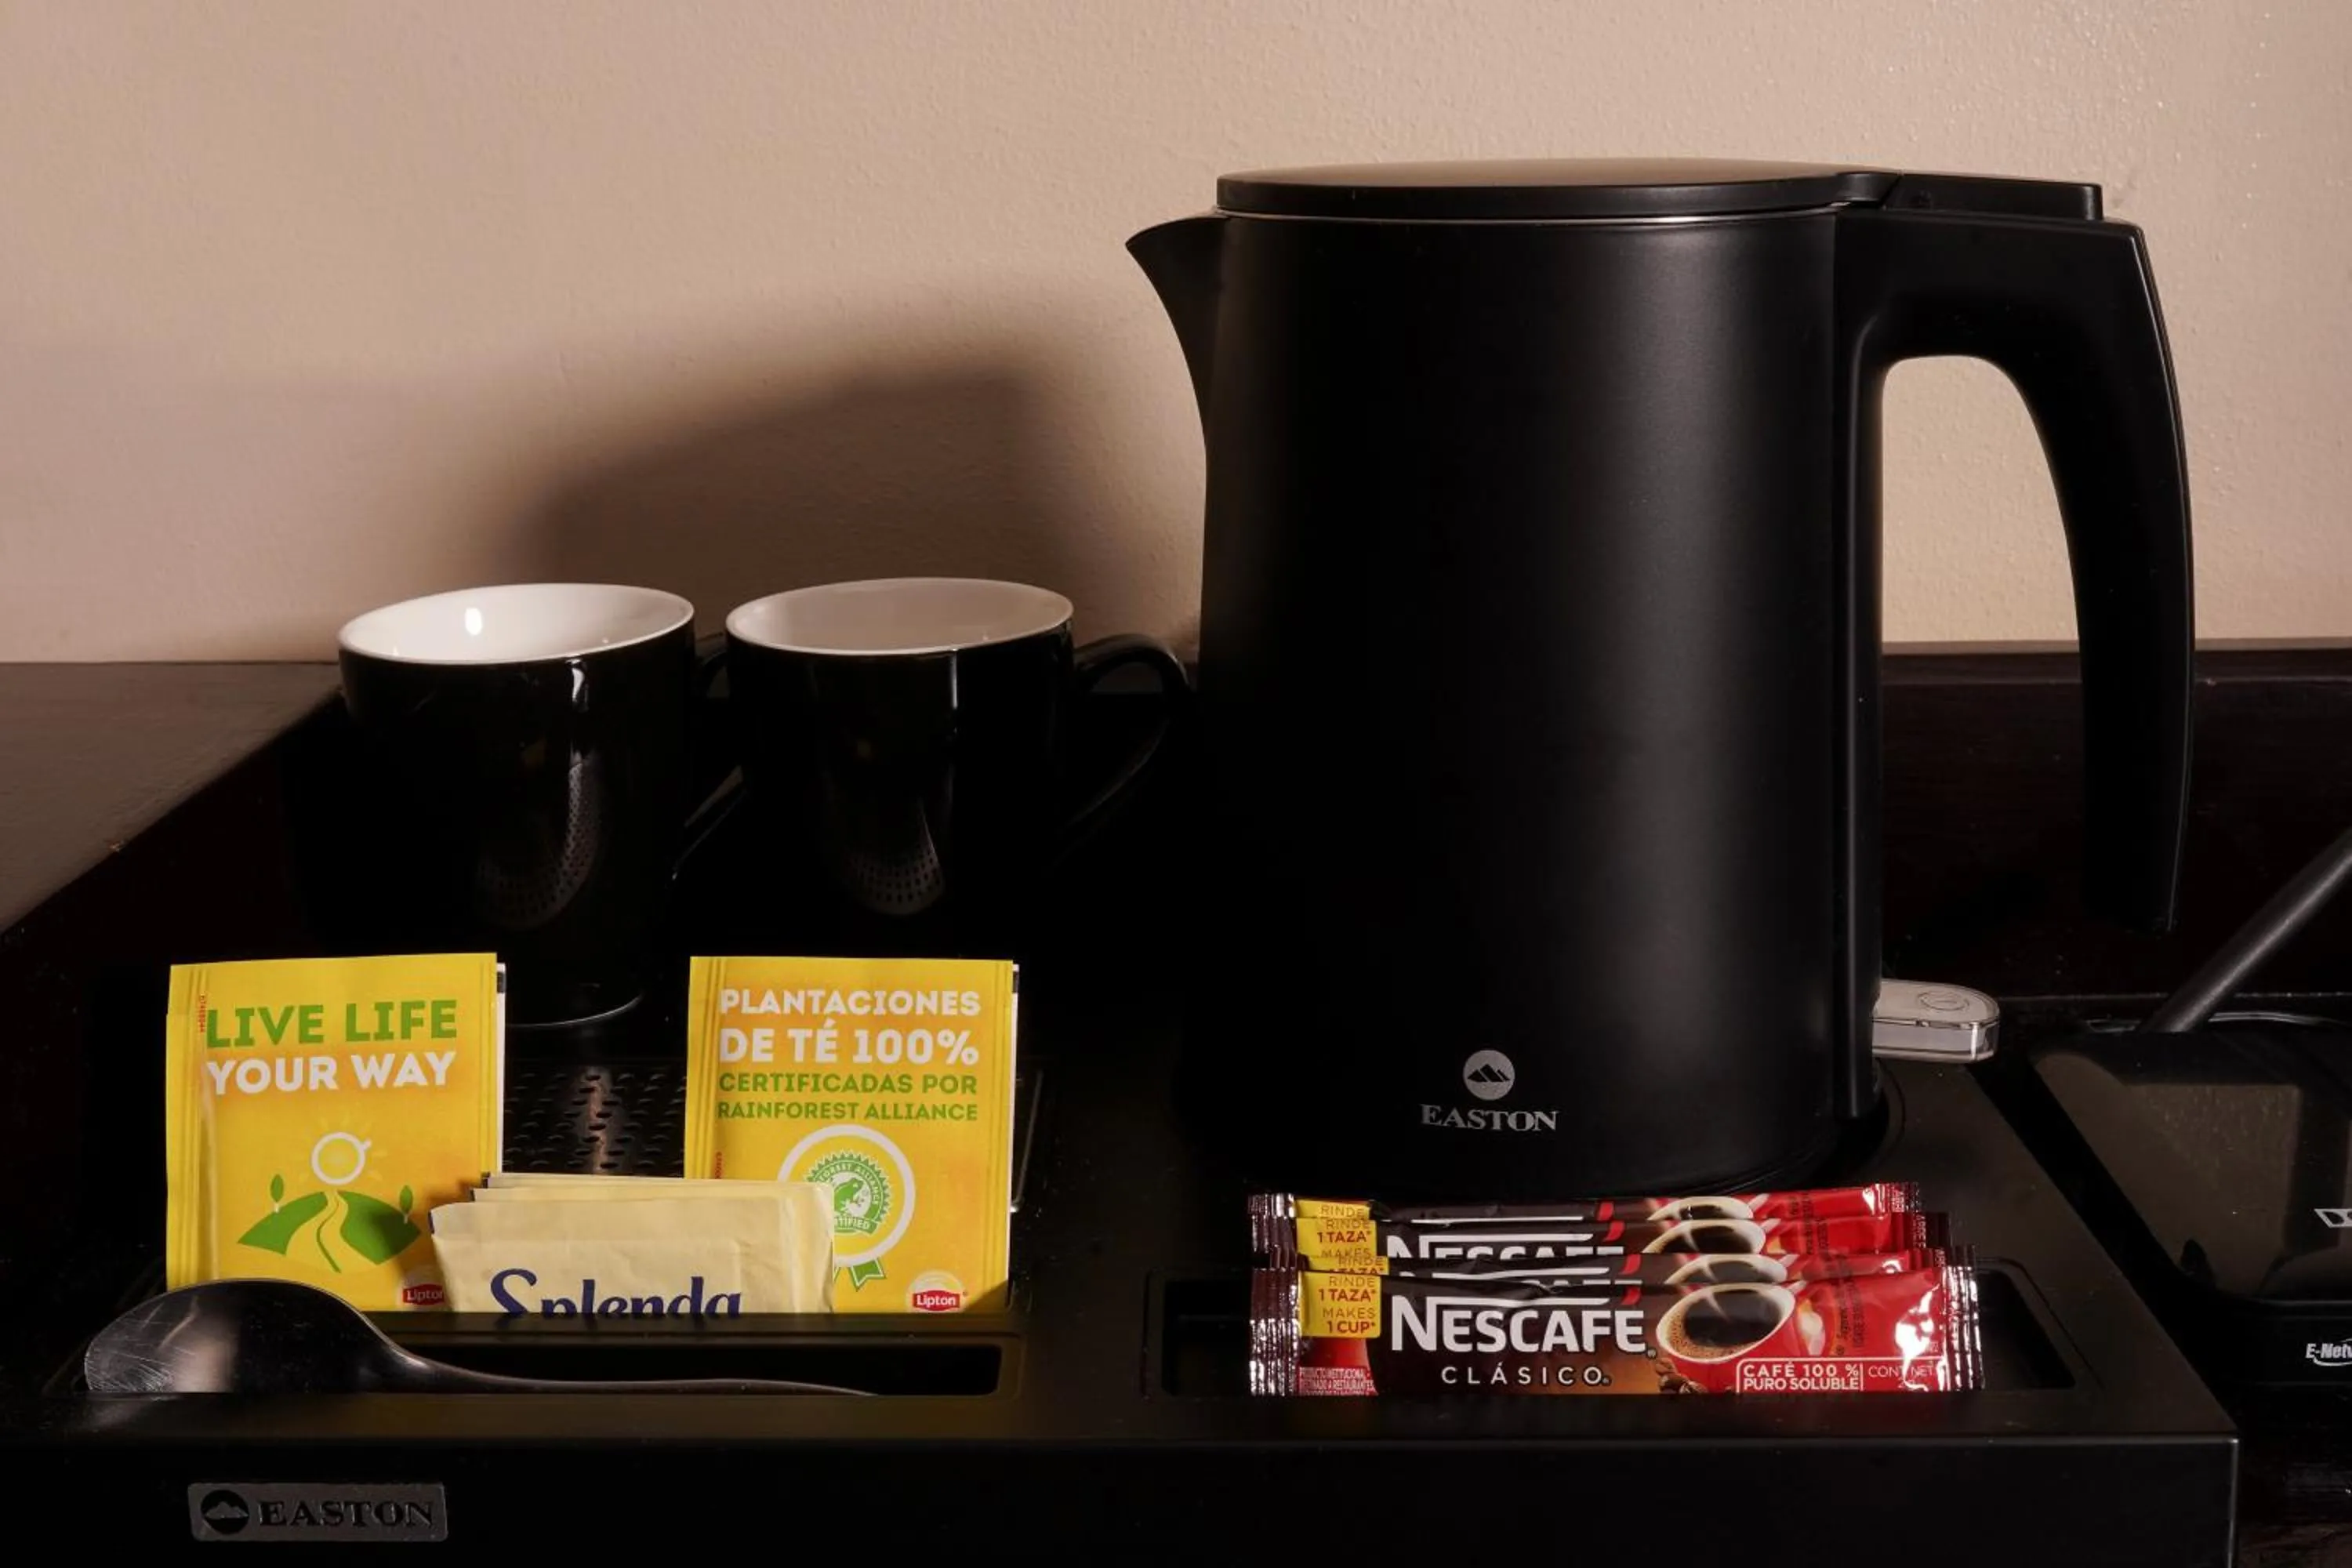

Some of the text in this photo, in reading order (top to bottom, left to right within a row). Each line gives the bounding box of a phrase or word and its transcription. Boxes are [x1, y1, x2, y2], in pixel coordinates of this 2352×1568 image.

[720, 989, 981, 1015] PLANTACIONES
[207, 1004, 324, 1048] LIVE
[346, 1000, 457, 1042] LIFE
[720, 1020, 979, 1065] DE TÉ 100%
[207, 1051, 456, 1095] YOUR WAY
[719, 1073, 977, 1094] CERTIFICADAS POR
[717, 1102, 978, 1121] RAINFOREST ALLIANCE
[1420, 1104, 1560, 1131] EASTON
[1320, 1205, 1364, 1218] RINDE
[1326, 1219, 1370, 1229] RINDE
[1317, 1232, 1323, 1243] 1
[1329, 1276, 1375, 1287] RINDE
[916, 1294, 956, 1308] Lipton
[1319, 1289, 1324, 1301] 1
[1323, 1308, 1375, 1319] MAKES
[1327, 1321, 1333, 1333] 1
[1442, 1363, 1603, 1385] CLÁSICO
[1743, 1361, 1859, 1377] CAFÉ 100 %
[1743, 1377, 1859, 1390] PURO SOLUBLE
[257, 1501, 433, 1527] EASTON
